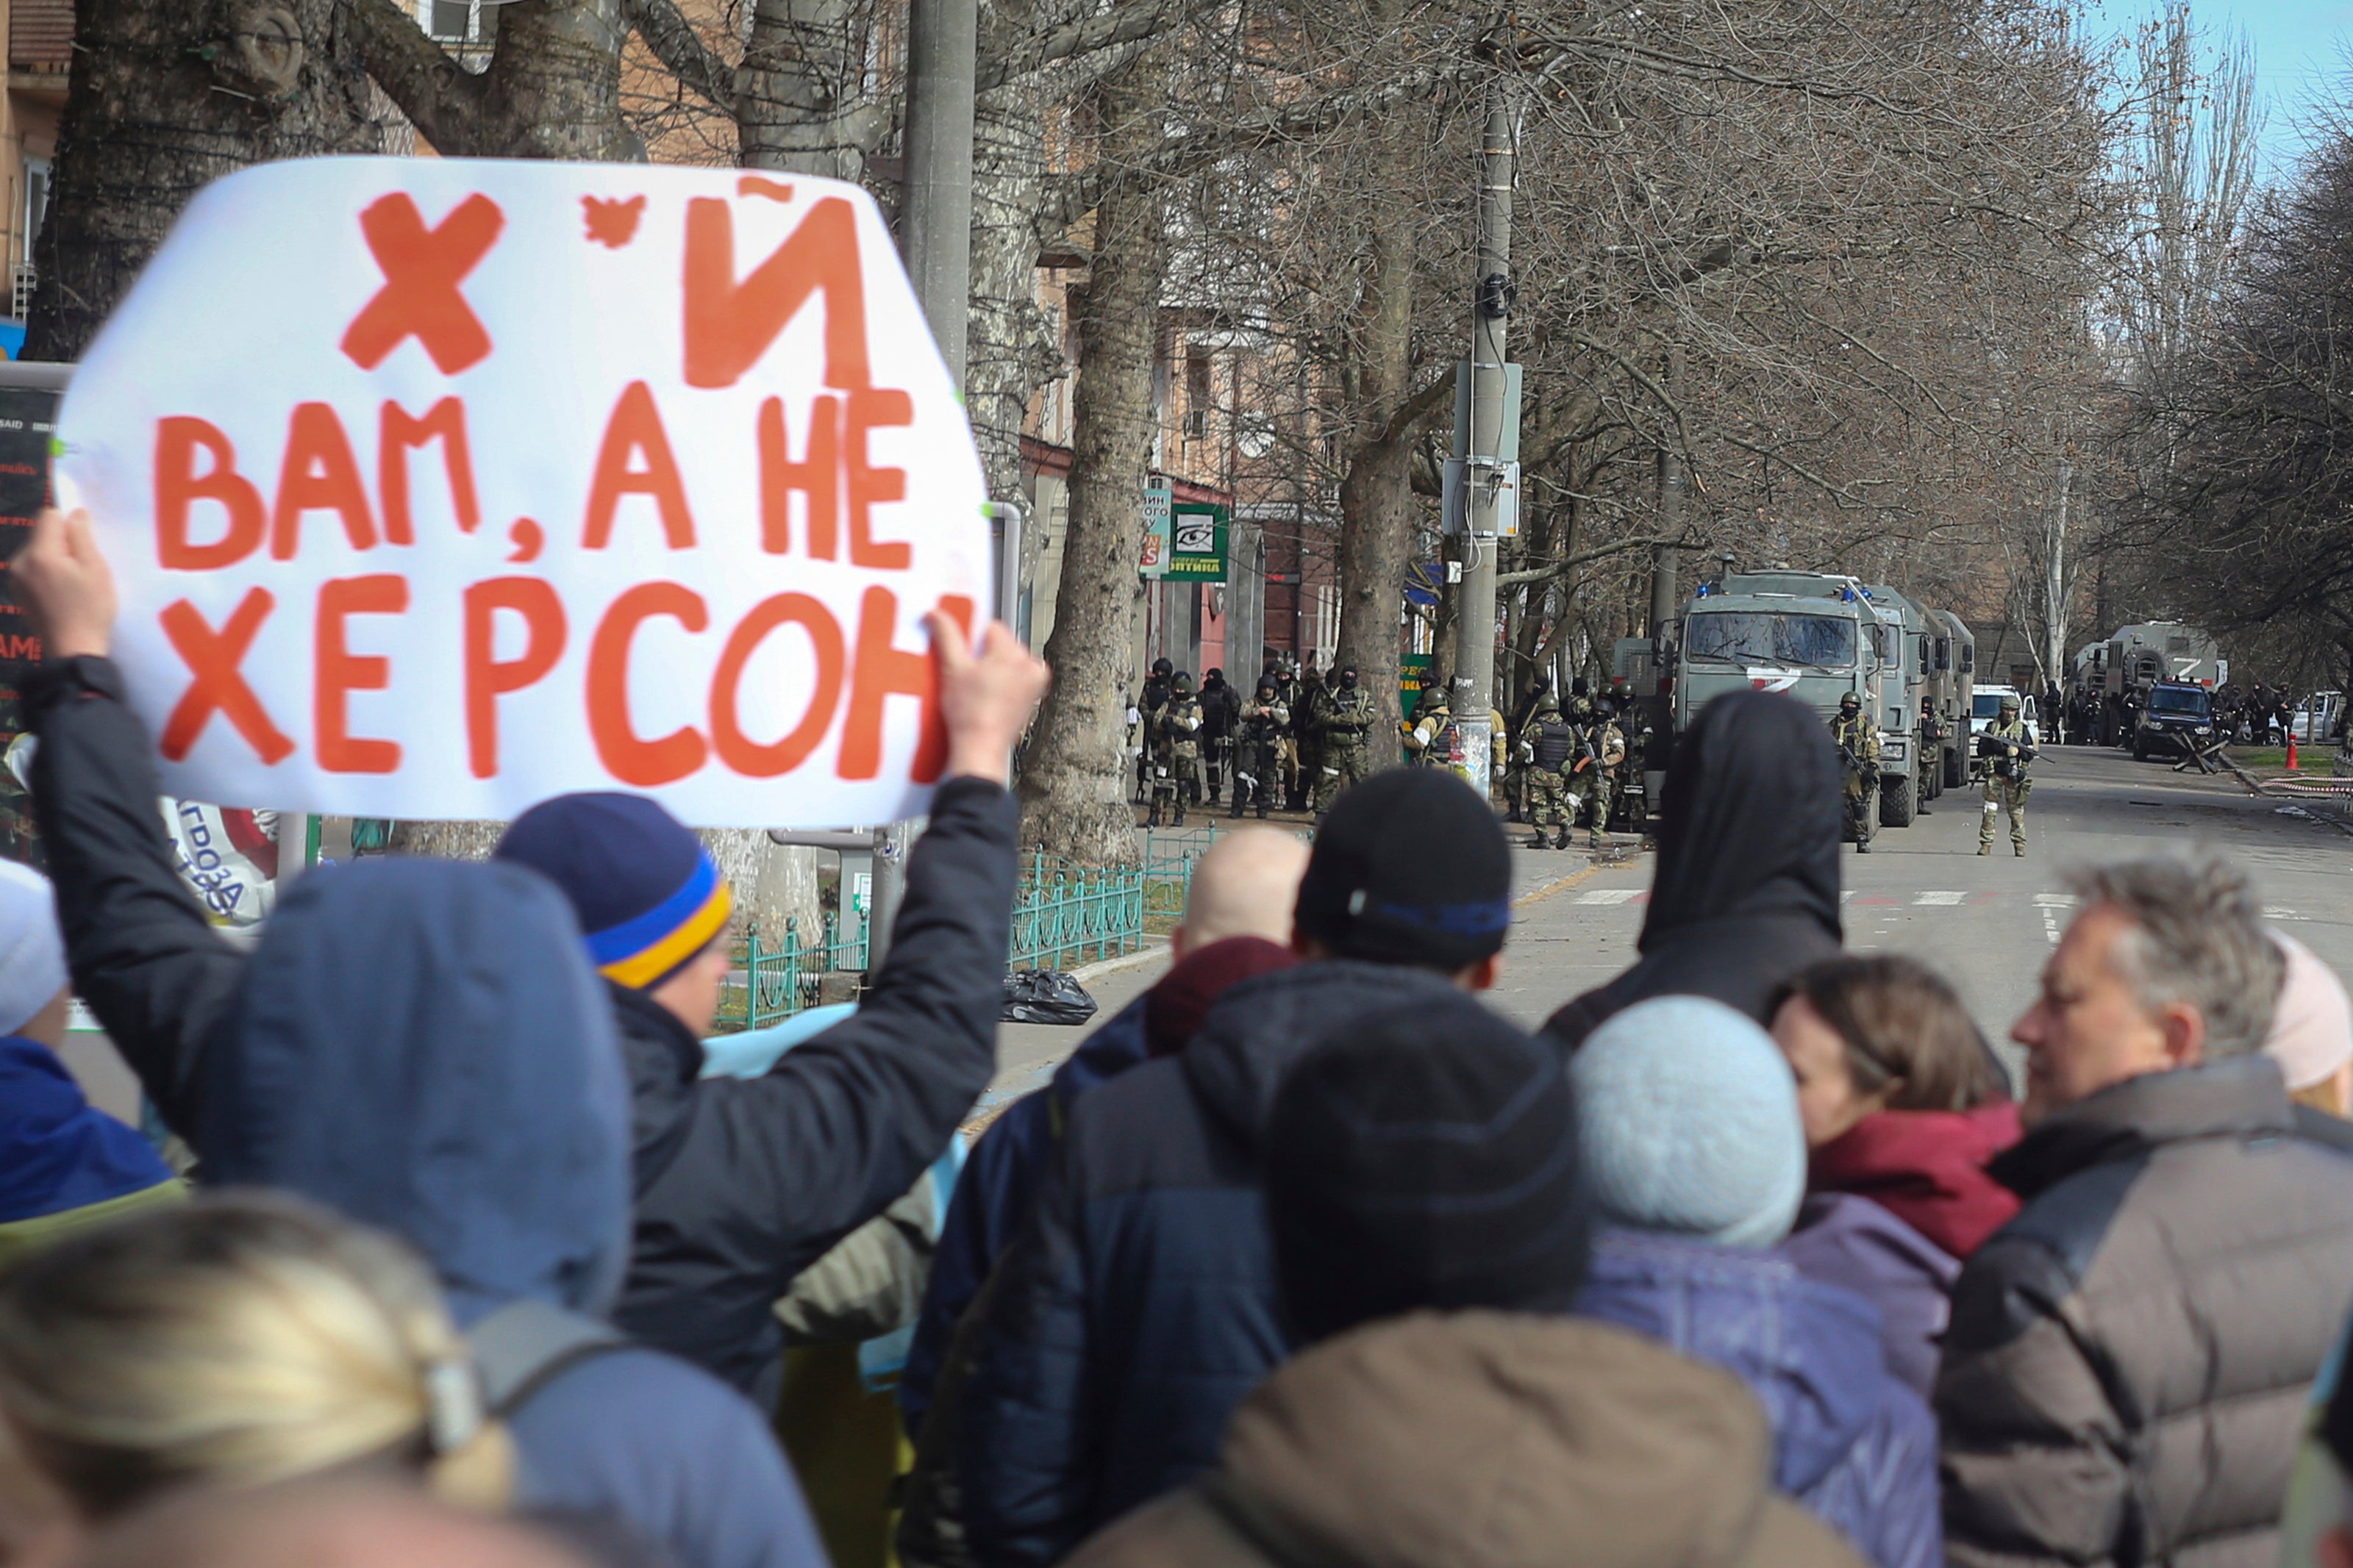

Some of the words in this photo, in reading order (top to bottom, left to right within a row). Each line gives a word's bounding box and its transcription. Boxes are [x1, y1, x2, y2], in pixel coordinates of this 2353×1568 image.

[154, 395, 544, 571] ВАМ,
[582, 380, 697, 551] А
[757, 387, 914, 571] НЕ
[158, 573, 975, 787] ХЕРСОН
